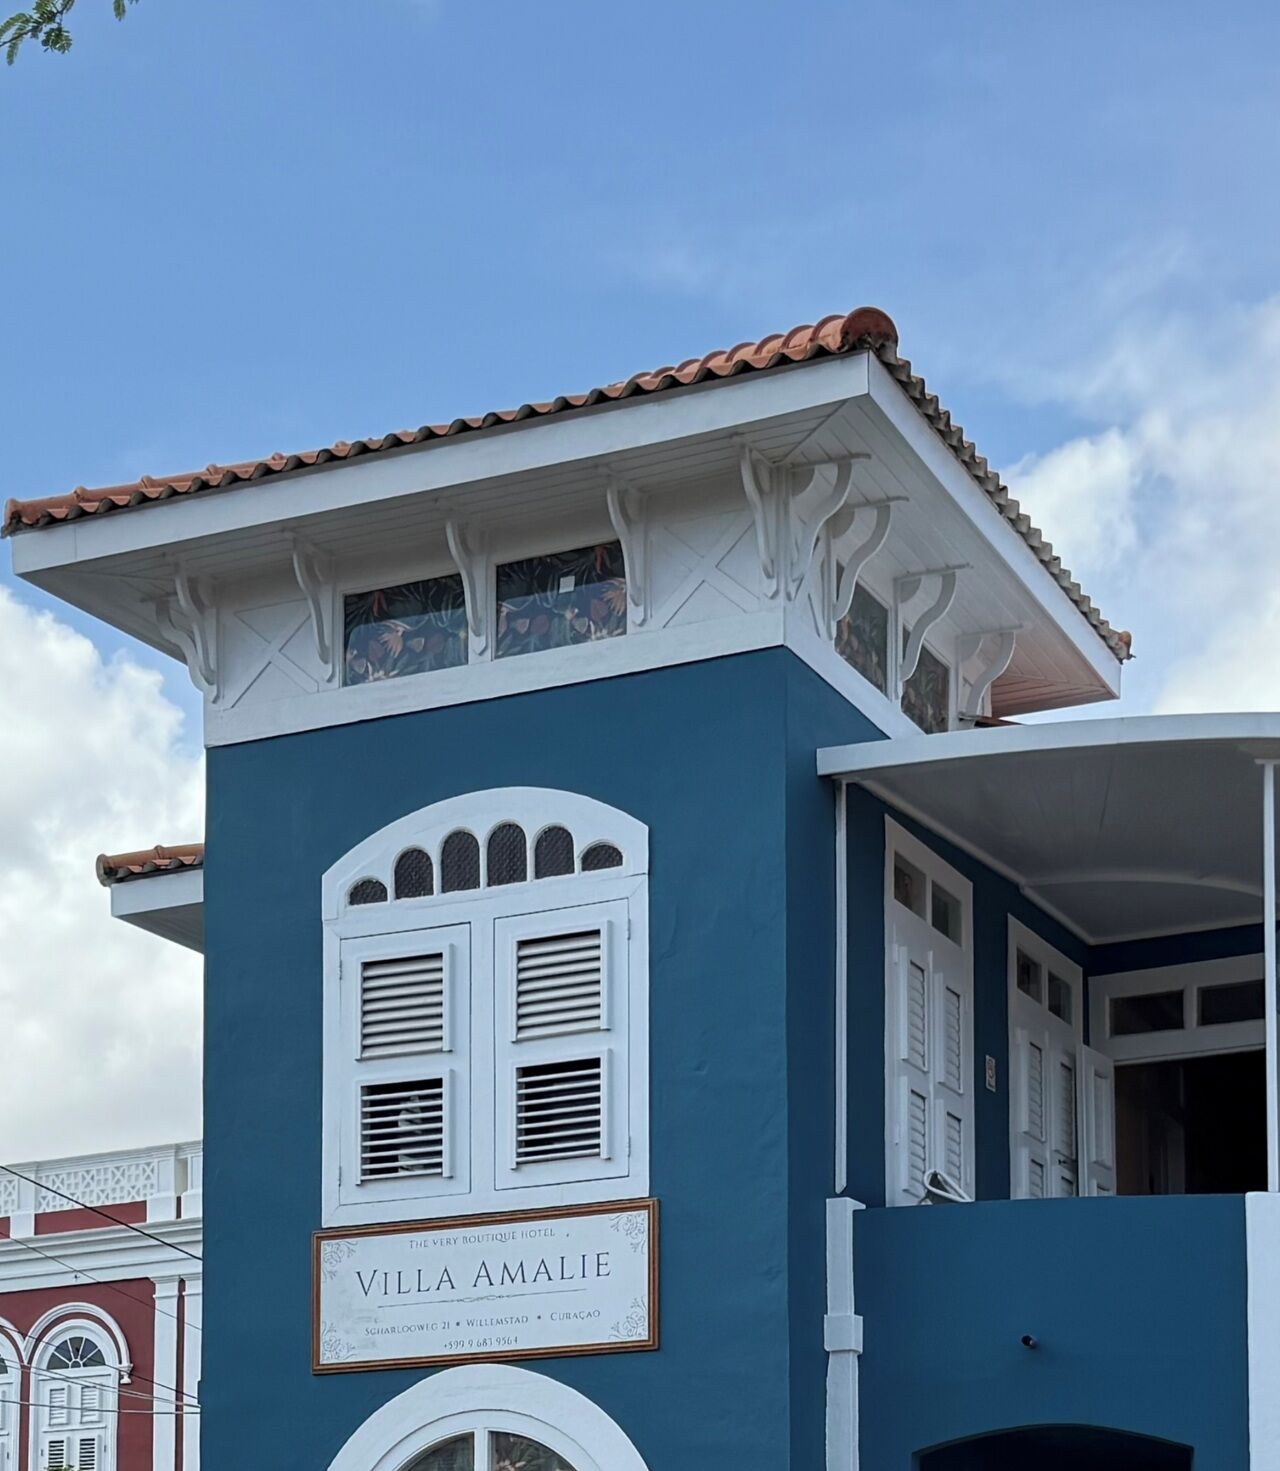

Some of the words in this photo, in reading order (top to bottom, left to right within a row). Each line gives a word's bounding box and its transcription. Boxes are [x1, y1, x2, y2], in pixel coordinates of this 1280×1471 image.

[408, 1239, 429, 1250] THE
[432, 1236, 459, 1247] VERY
[461, 1230, 517, 1245] BOUTIQUE
[520, 1228, 556, 1240] HOTEL
[355, 1265, 457, 1297] VILLA
[472, 1251, 612, 1288] AMALIE
[466, 1314, 529, 1328] WILLEMSTAD
[549, 1308, 601, 1322] CURAÇAO
